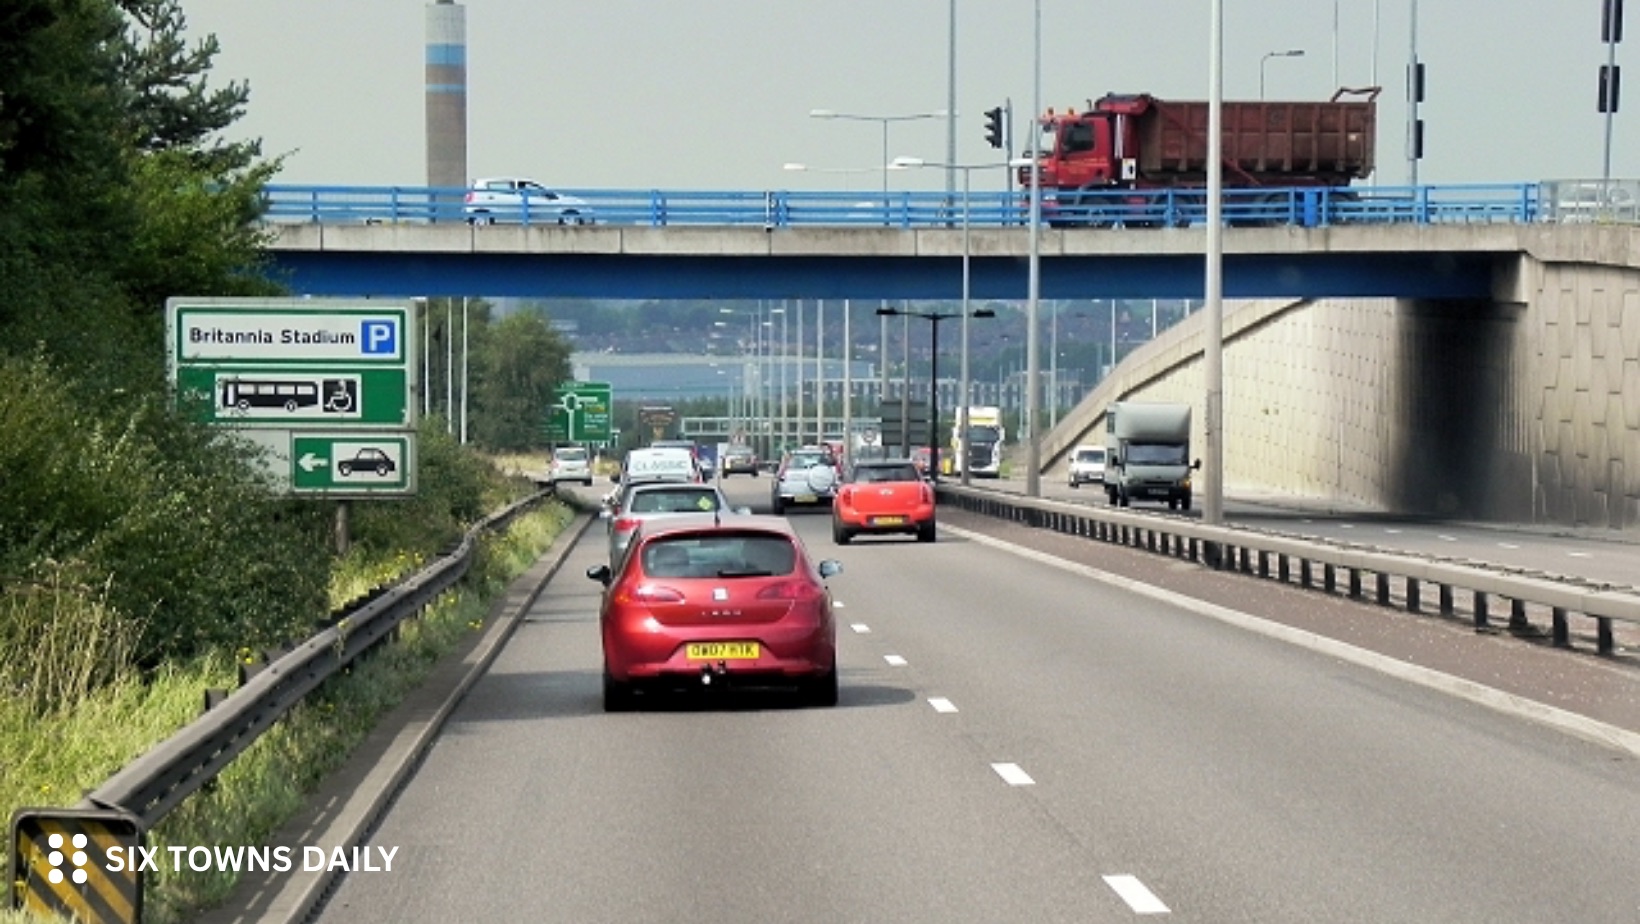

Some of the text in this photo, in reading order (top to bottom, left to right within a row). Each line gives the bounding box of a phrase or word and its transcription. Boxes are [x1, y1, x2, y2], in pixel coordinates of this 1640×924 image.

[189, 324, 391, 351] Britannia Stadium P
